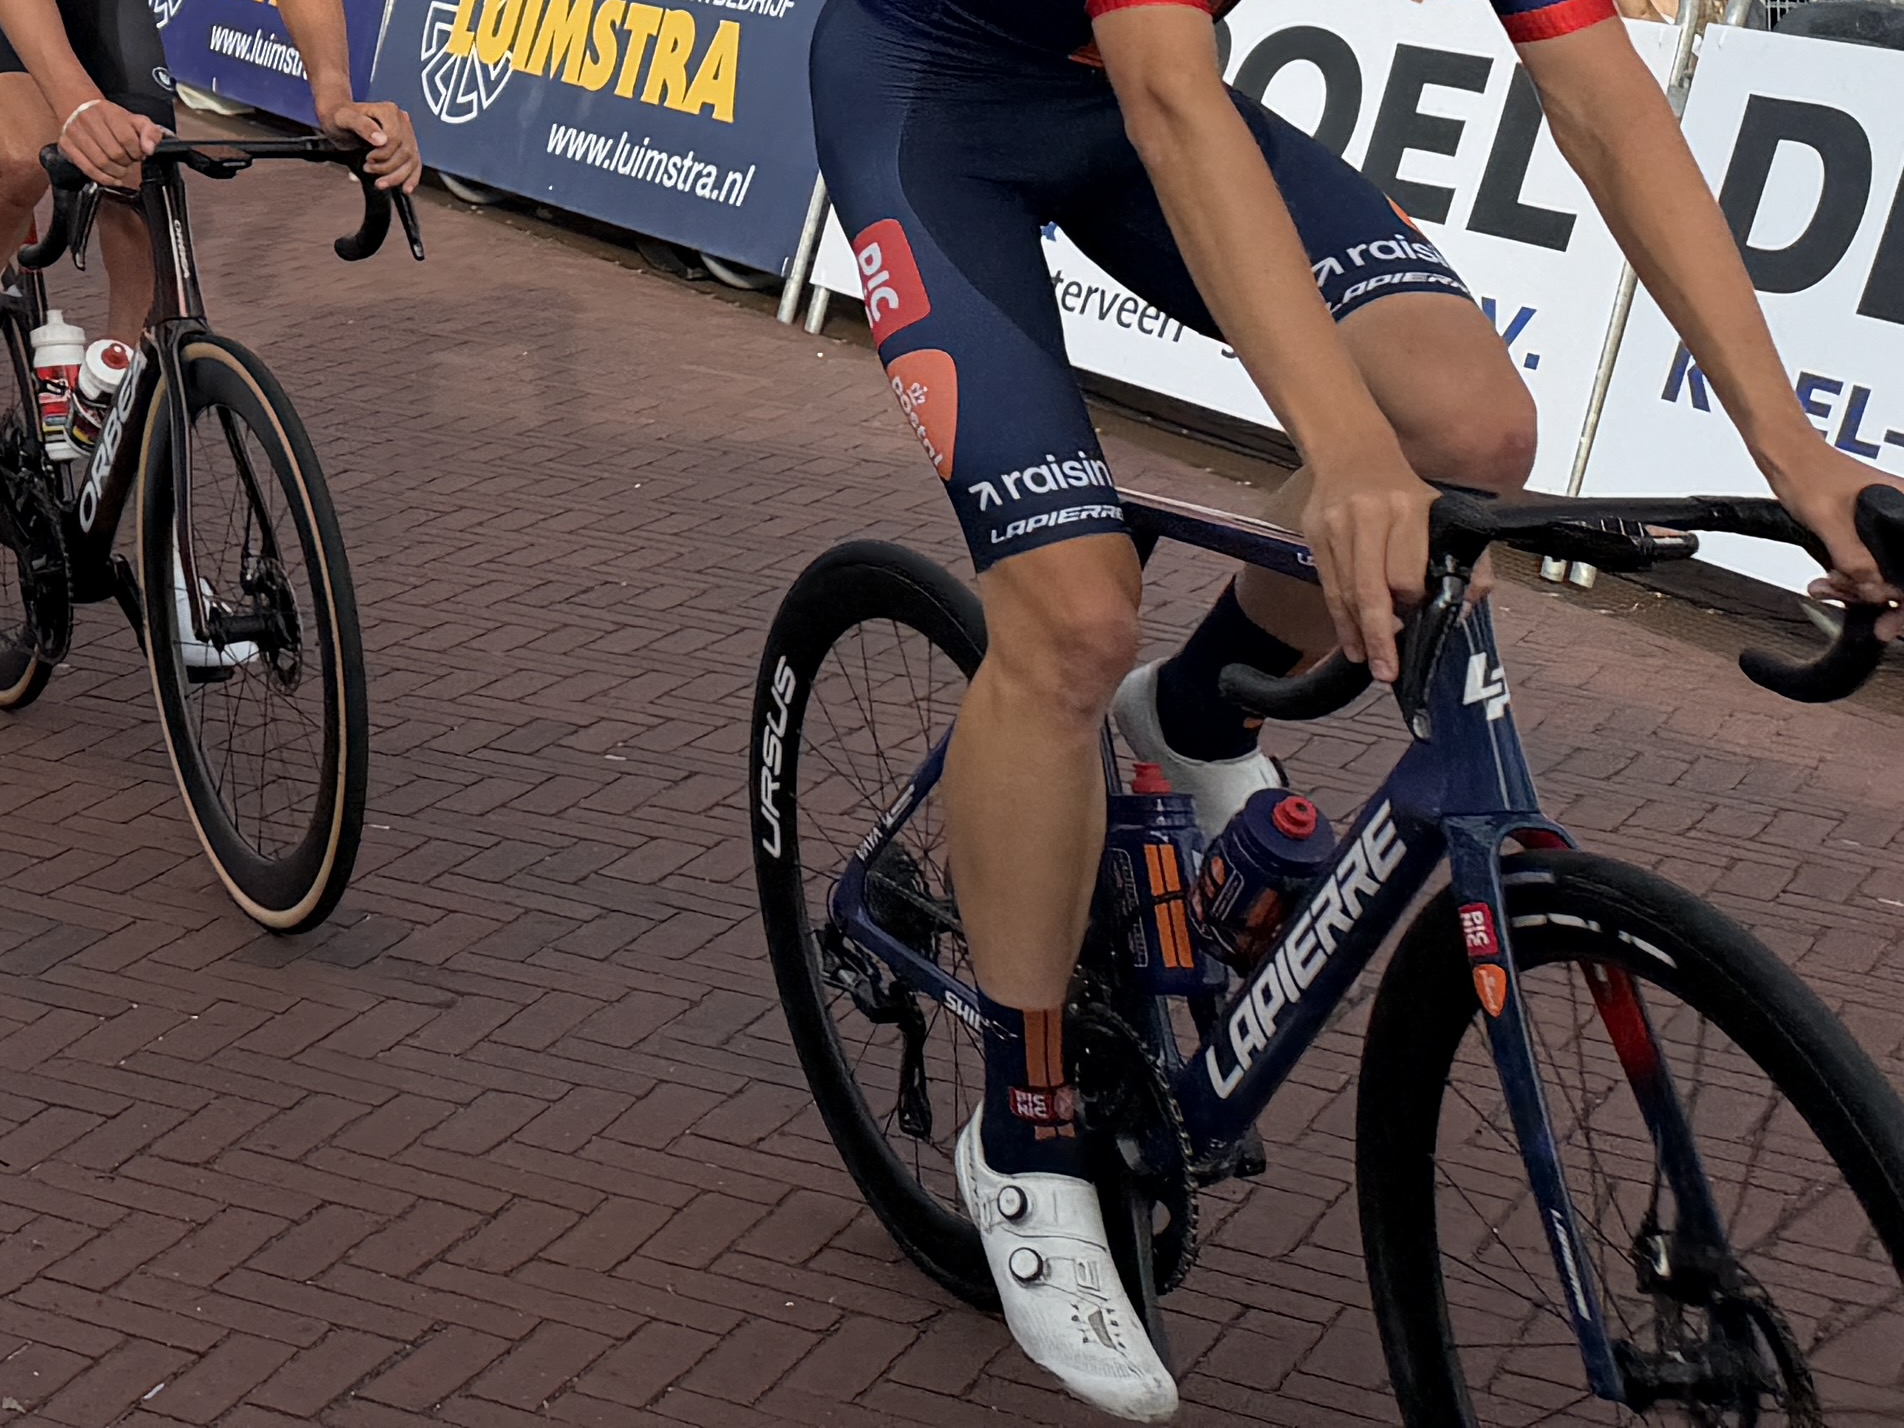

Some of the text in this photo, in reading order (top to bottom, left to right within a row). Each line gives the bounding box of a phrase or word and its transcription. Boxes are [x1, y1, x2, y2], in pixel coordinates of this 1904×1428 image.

[210, 25, 308, 80] www.luimstr
[546, 122, 756, 208] www.luimstra.nl
[1216, 20, 1578, 252] OEL
[1660, 338, 1904, 462] KEL-
[1002, 450, 1115, 500] raisin
[759, 655, 797, 859] URSUS
[1206, 799, 1408, 1100] LAPIERRE
